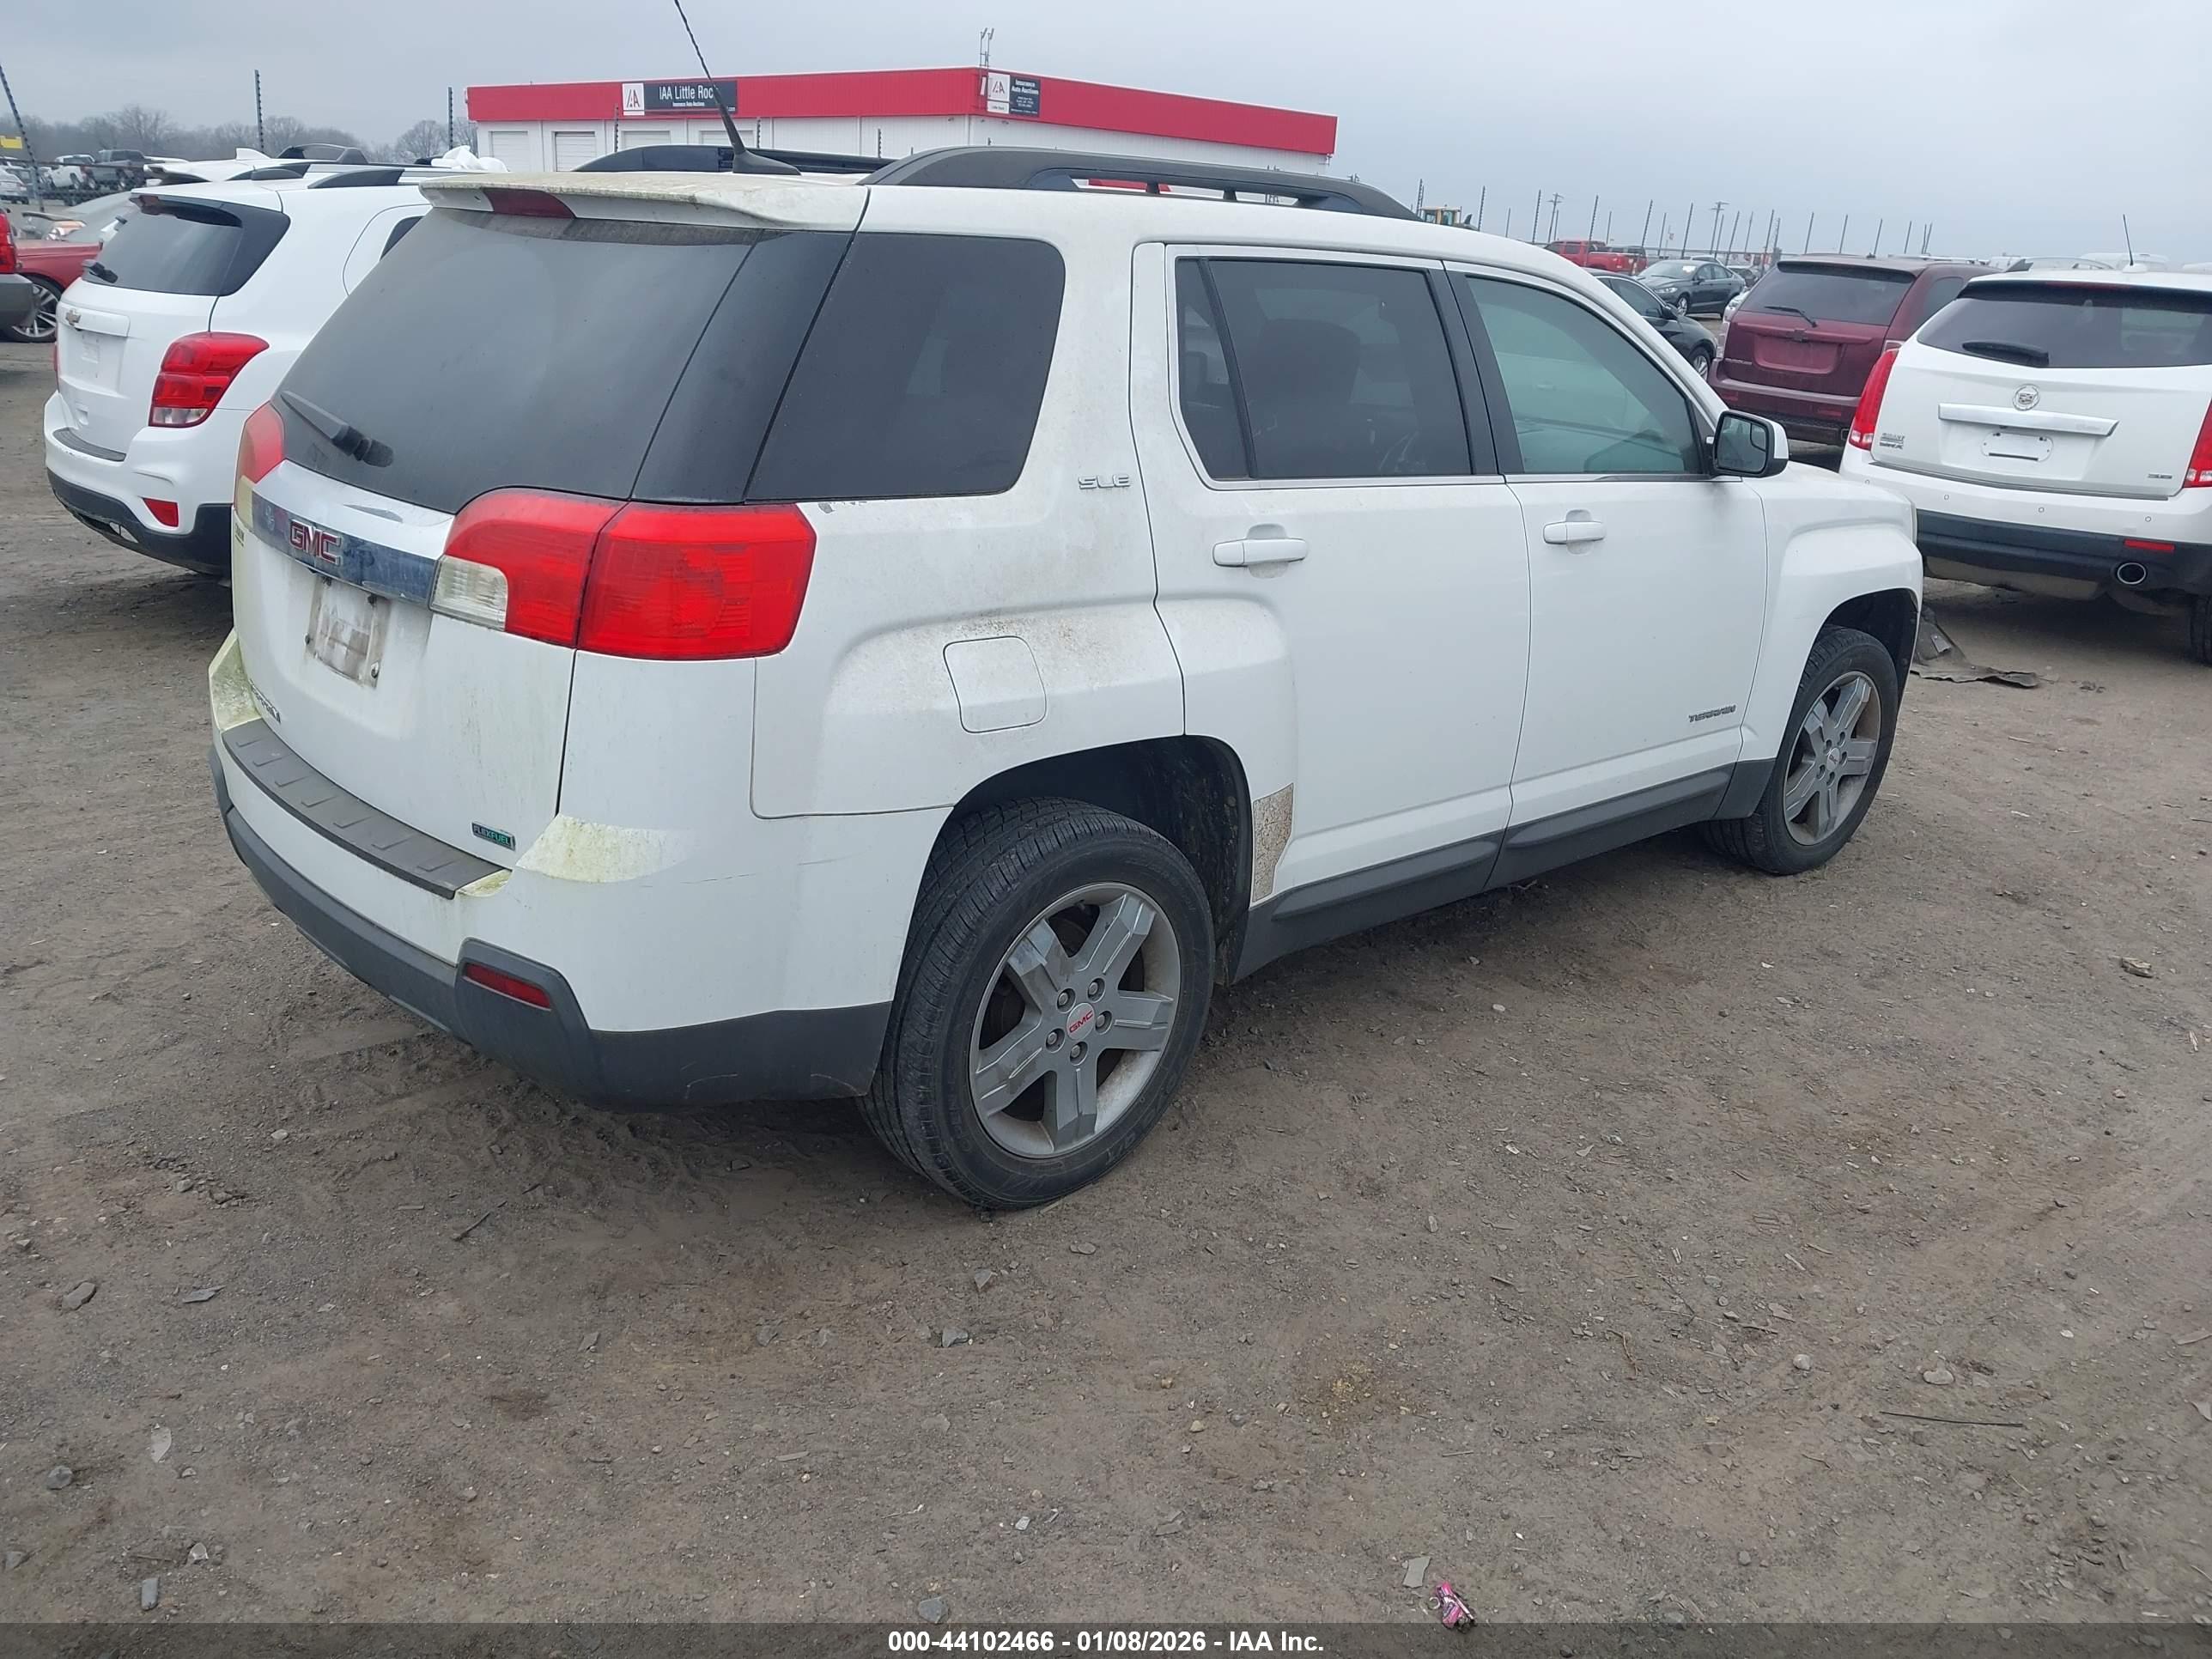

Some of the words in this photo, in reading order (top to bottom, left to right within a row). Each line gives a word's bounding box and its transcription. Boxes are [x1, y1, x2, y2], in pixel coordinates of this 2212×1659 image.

[659, 86, 673, 100] IAA
[674, 85, 696, 100] Little
[697, 84, 716, 99] Roc
[1079, 474, 1130, 489] SLE
[289, 520, 343, 566] GMC
[1069, 1010, 1094, 1033] GMC
